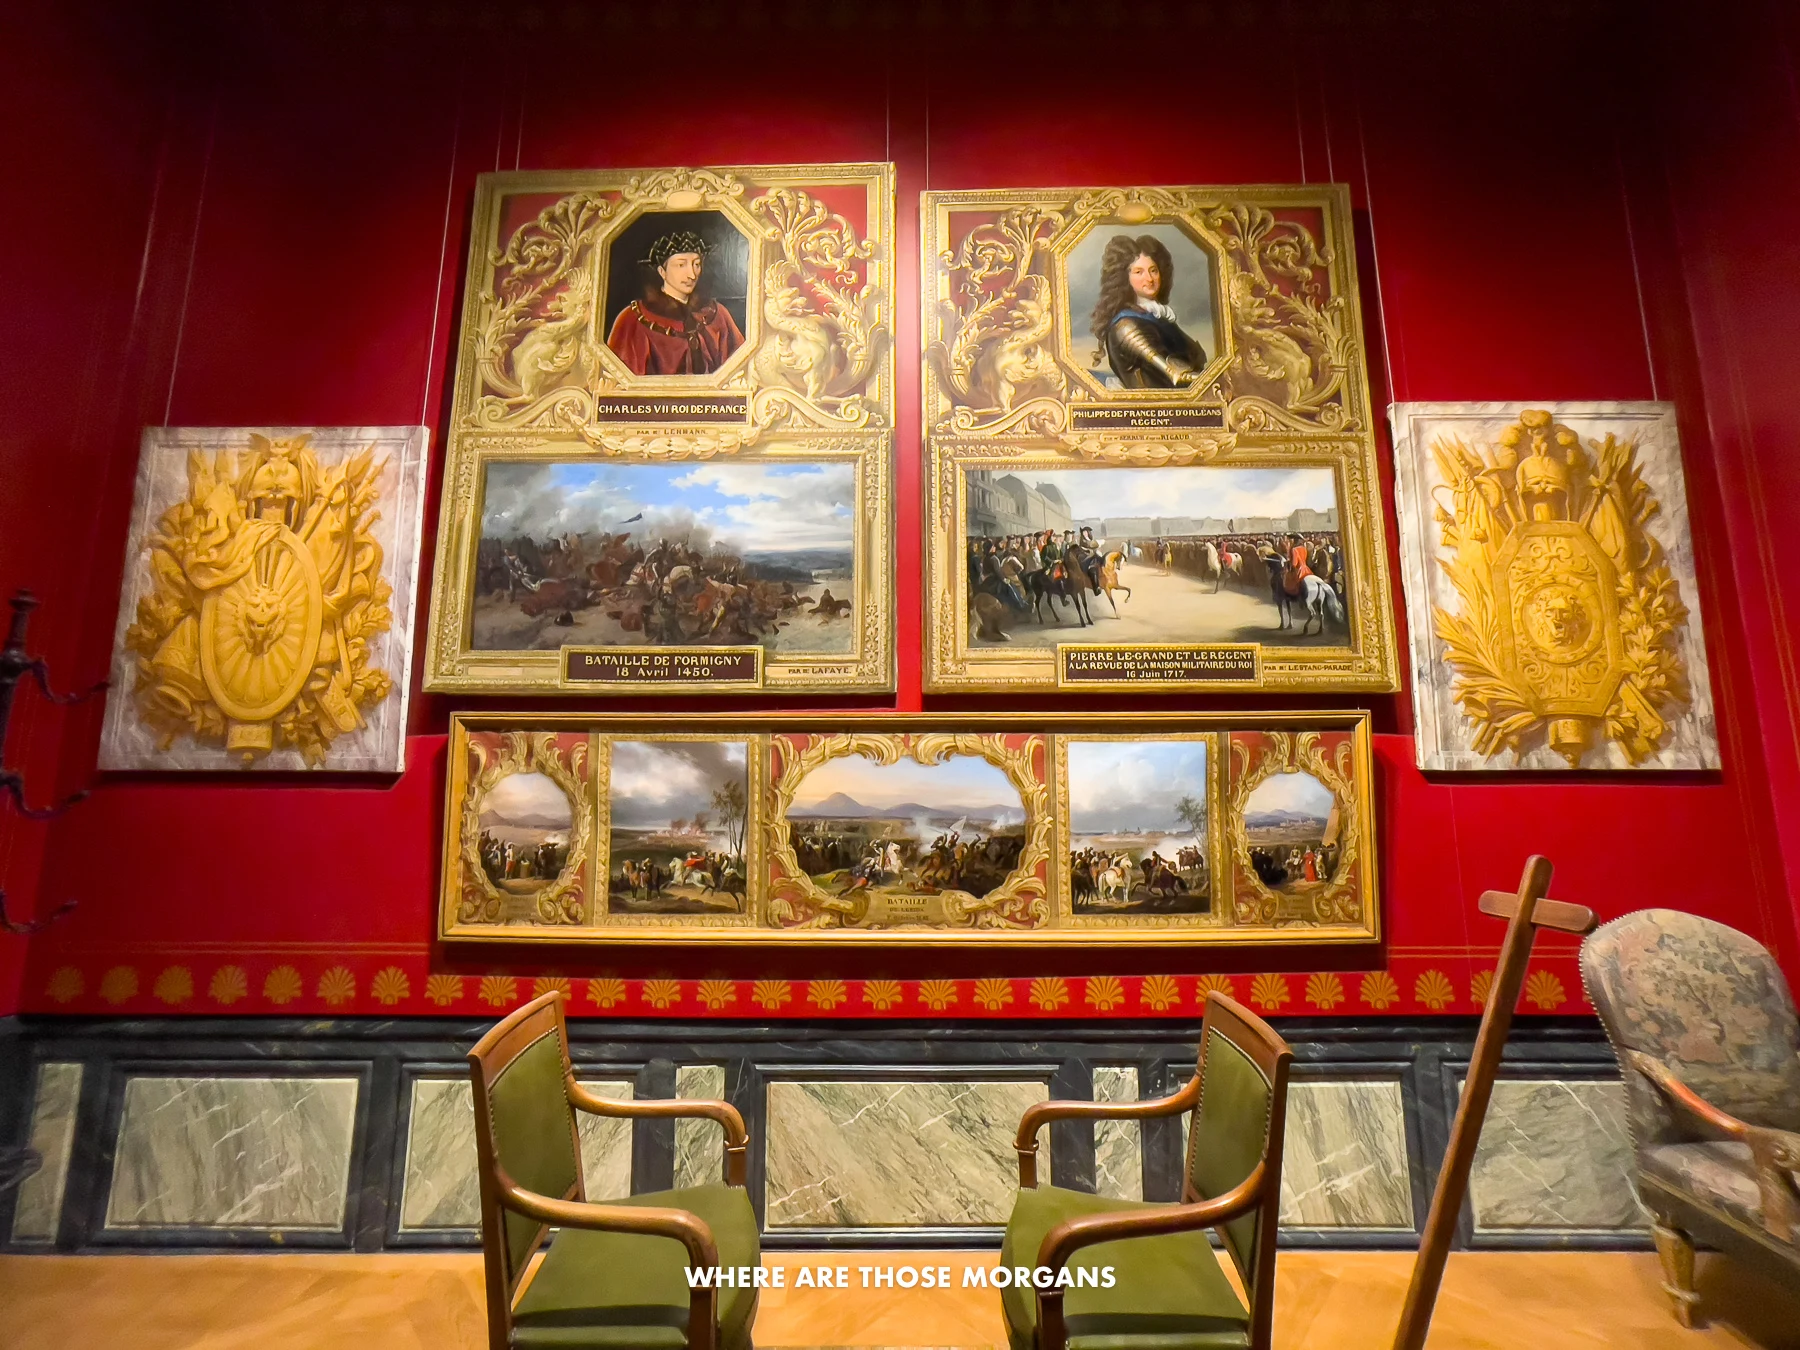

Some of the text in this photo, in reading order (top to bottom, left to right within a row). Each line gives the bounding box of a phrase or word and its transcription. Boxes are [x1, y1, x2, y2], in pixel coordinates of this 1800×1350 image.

[598, 404, 747, 414] CHARLES VII ROI DE FRANCE
[1072, 410, 1111, 419] PHILIPPE
[1111, 410, 1123, 418] DE
[1123, 409, 1157, 418] FRANCE
[1157, 409, 1175, 417] DUC
[585, 655, 742, 666] BATAILLE DE FORMIGNY
[1070, 652, 1113, 661] PIERRE
[1175, 651, 1191, 660] ET
[1193, 651, 1208, 660] LE
[1075, 661, 1088, 670] LA
[1089, 661, 1123, 670] REVUE
[1123, 661, 1136, 669] DE
[1136, 661, 1149, 669] LA
[1149, 661, 1181, 669] MAISON
[1181, 660, 1224, 669] MILITAIRE
[1224, 660, 1237, 669] DU
[1238, 660, 1253, 669] ROI
[616, 667, 714, 677] 18 Avril 1450.
[1126, 670, 1187, 678] 16 Juin 1717.
